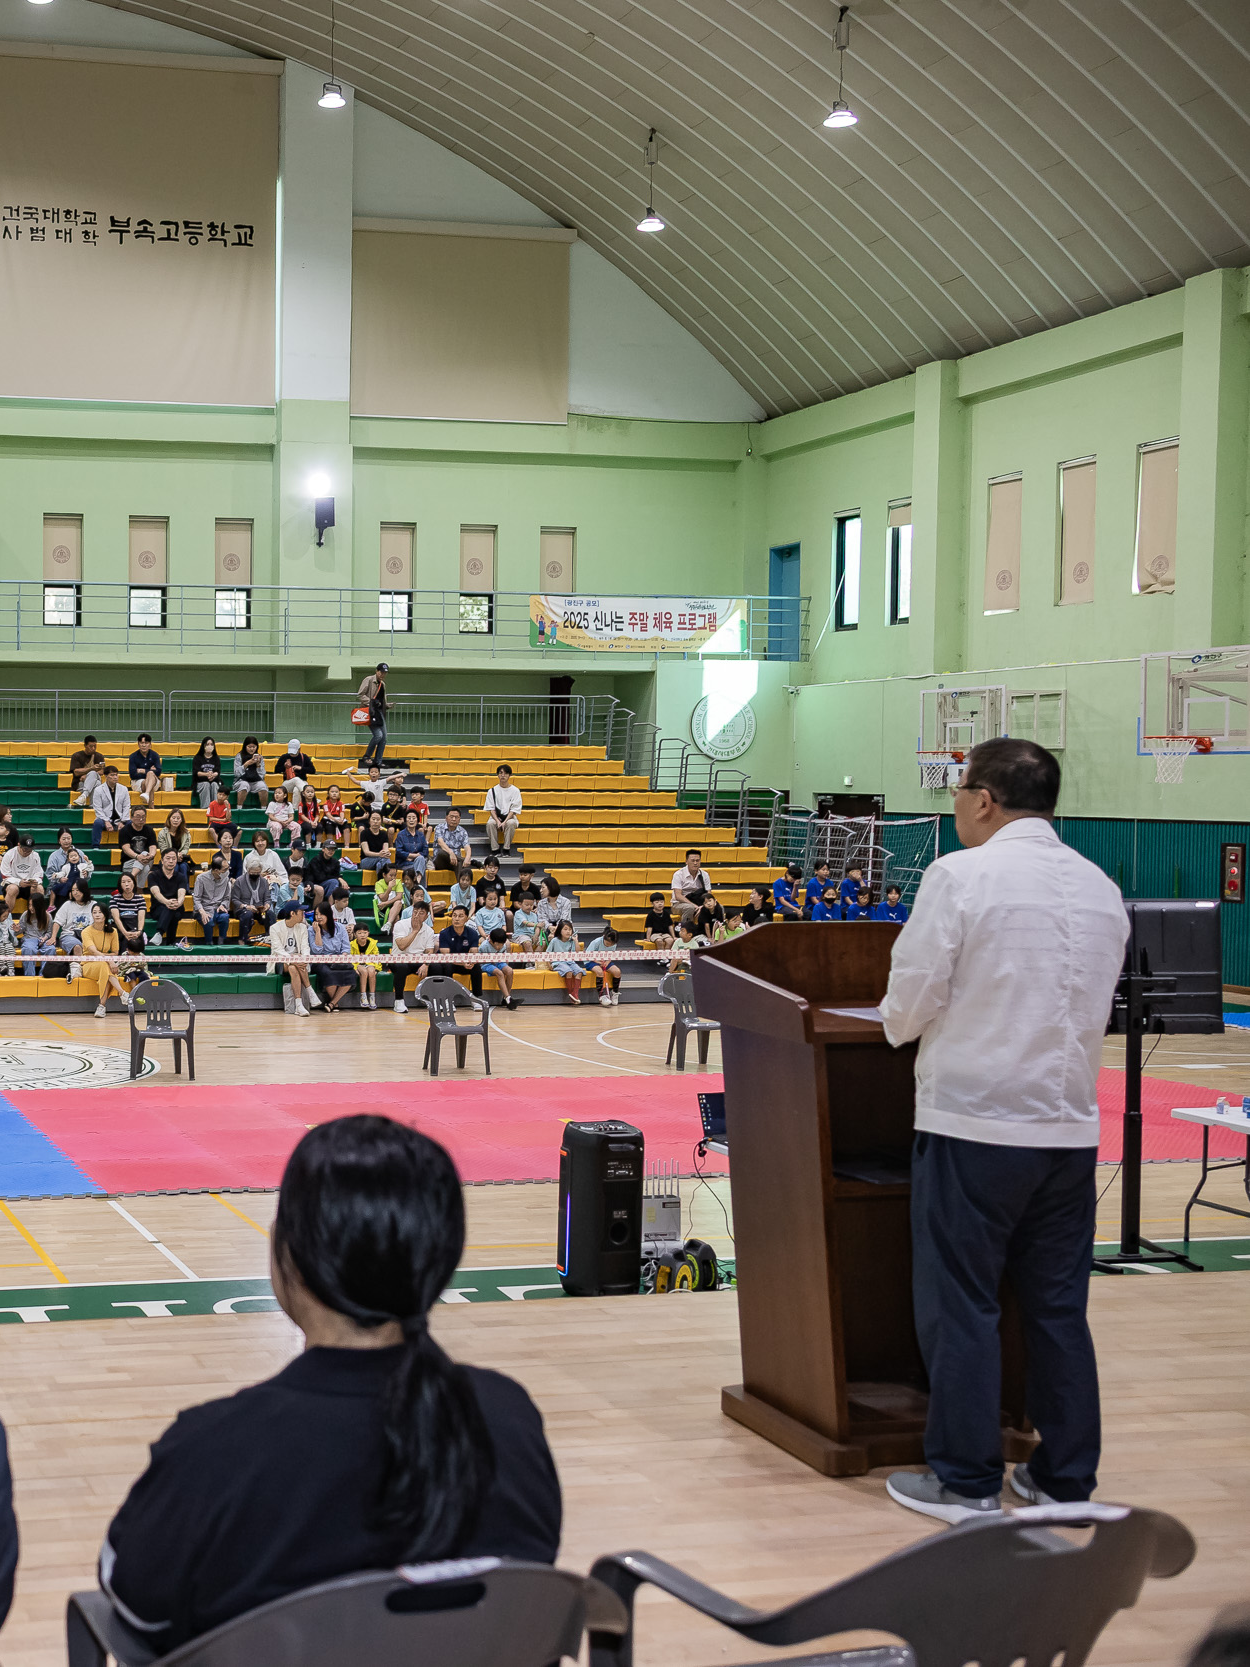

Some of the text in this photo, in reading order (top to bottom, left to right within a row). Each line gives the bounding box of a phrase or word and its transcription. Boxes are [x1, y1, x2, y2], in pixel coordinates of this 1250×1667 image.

[2, 205, 98, 226] 건국대학교
[108, 215, 255, 248] 부속고등학교
[563, 610, 717, 632] 2025 신나는 주말 체육 프로그램
